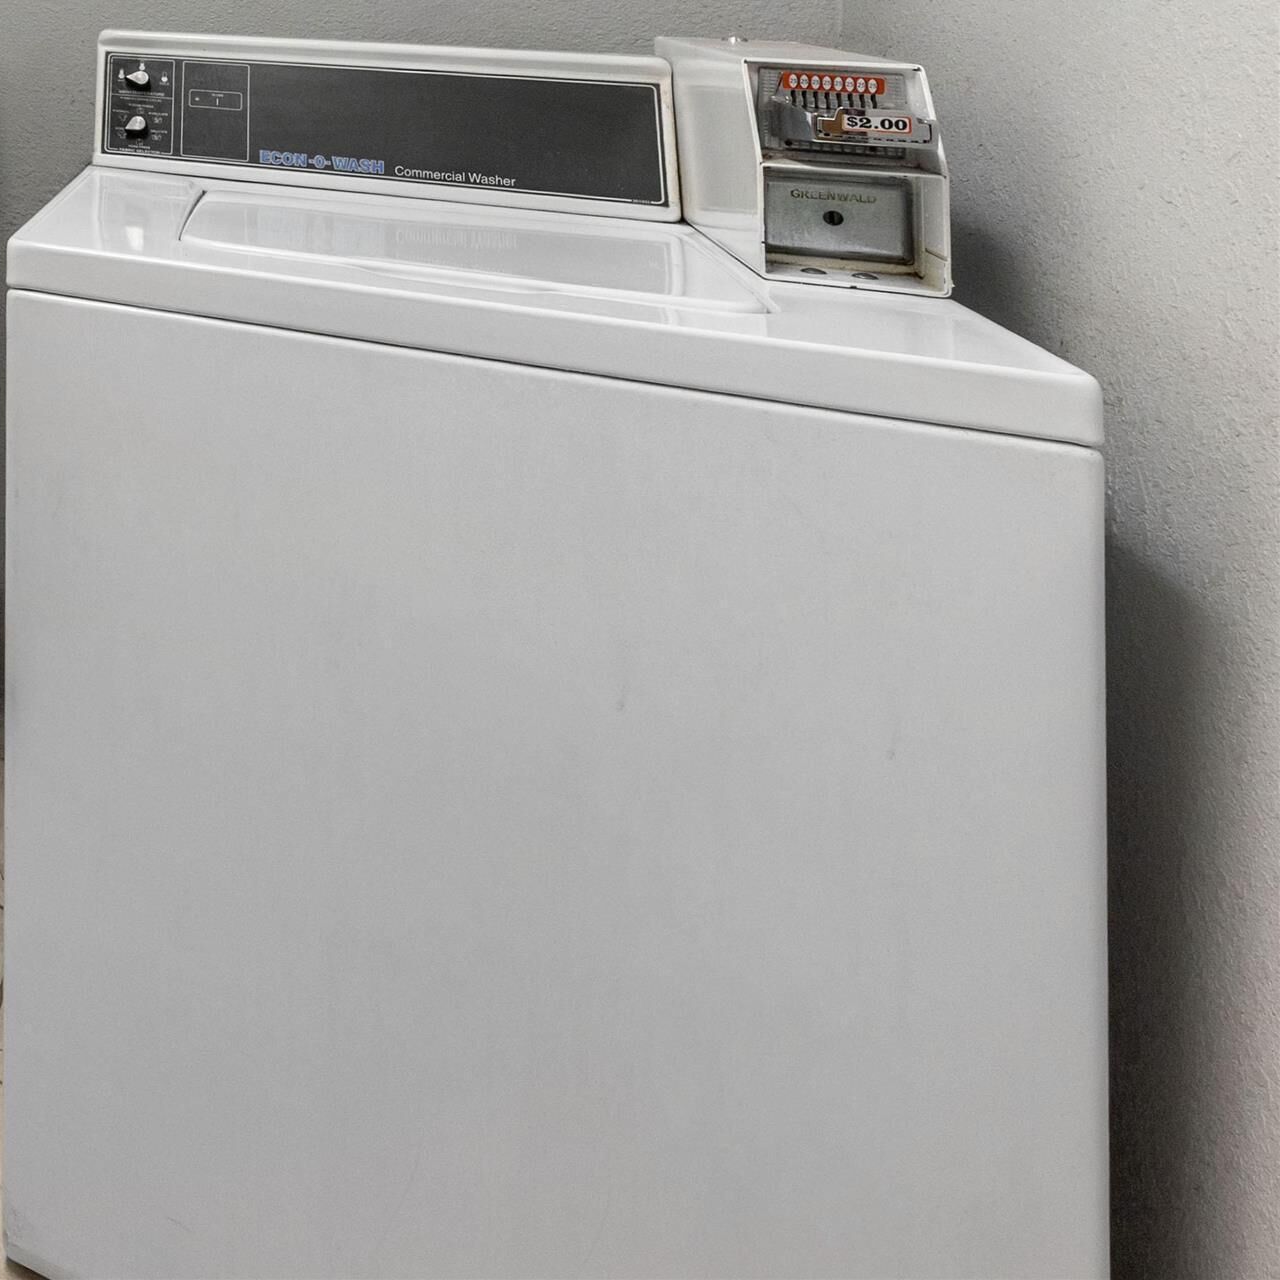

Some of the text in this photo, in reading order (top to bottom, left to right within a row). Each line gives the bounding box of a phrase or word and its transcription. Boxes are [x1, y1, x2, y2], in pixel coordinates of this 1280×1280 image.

[846, 116, 908, 131] $2.00
[394, 165, 466, 182] Commercial
[468, 171, 516, 187] Washer
[790, 188, 877, 204] GREENWALD
